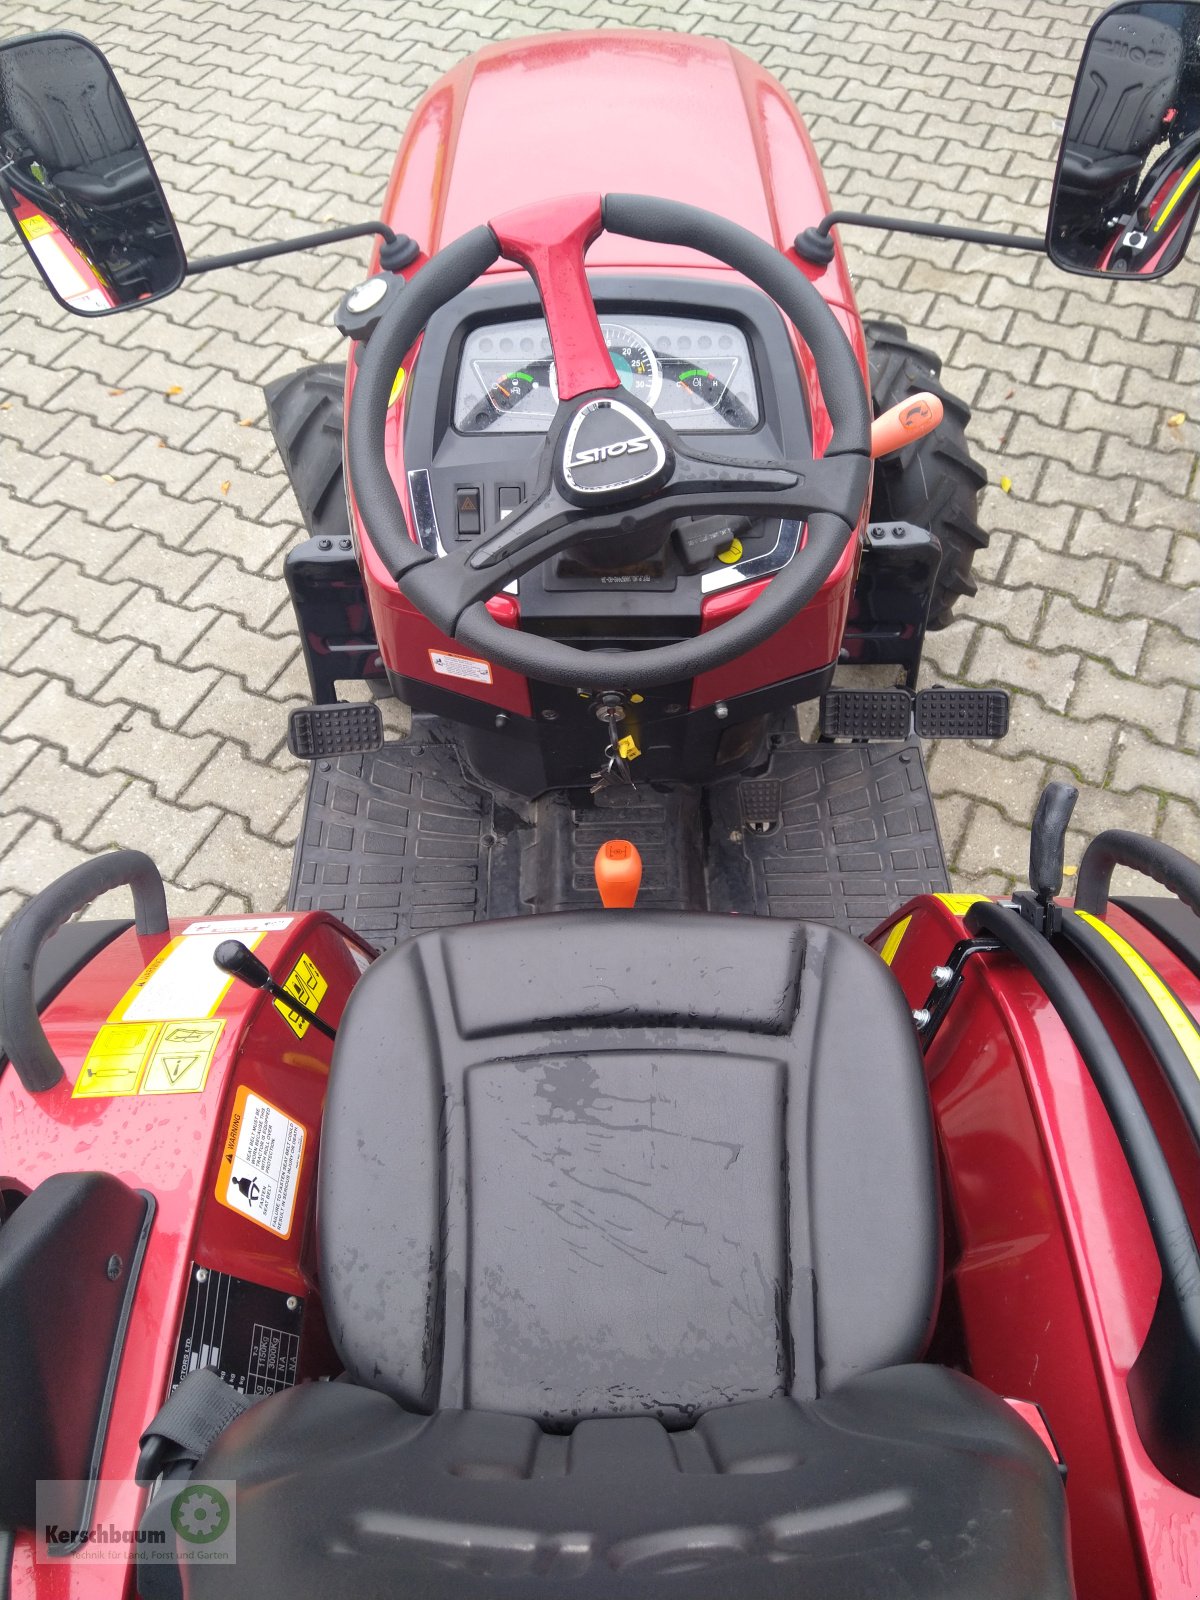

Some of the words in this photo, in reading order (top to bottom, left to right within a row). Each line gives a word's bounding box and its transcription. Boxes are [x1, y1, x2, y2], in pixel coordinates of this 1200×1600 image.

[255, 1107, 260, 1116] BE
[228, 1114, 241, 1150] WARNING
[254, 1120, 263, 1146] BECAUSE
[256, 1141, 265, 1168] TRACTOR
[262, 1107, 271, 1134] EQUIPPED
[290, 1145, 295, 1154] OR
[287, 1154, 295, 1174] INJURY
[278, 1172, 286, 1193] FASTEN
[282, 1175, 290, 1200] SERIOUS
[275, 1194, 281, 1202] TO
[272, 1203, 281, 1228] FAILURE
[277, 1208, 285, 1230] RESULT
[258, 1336, 268, 1367] 1150Kg
[268, 1338, 278, 1369] 3000Kg
[230, 1374, 235, 1382] kg
[239, 1376, 245, 1385] kg
